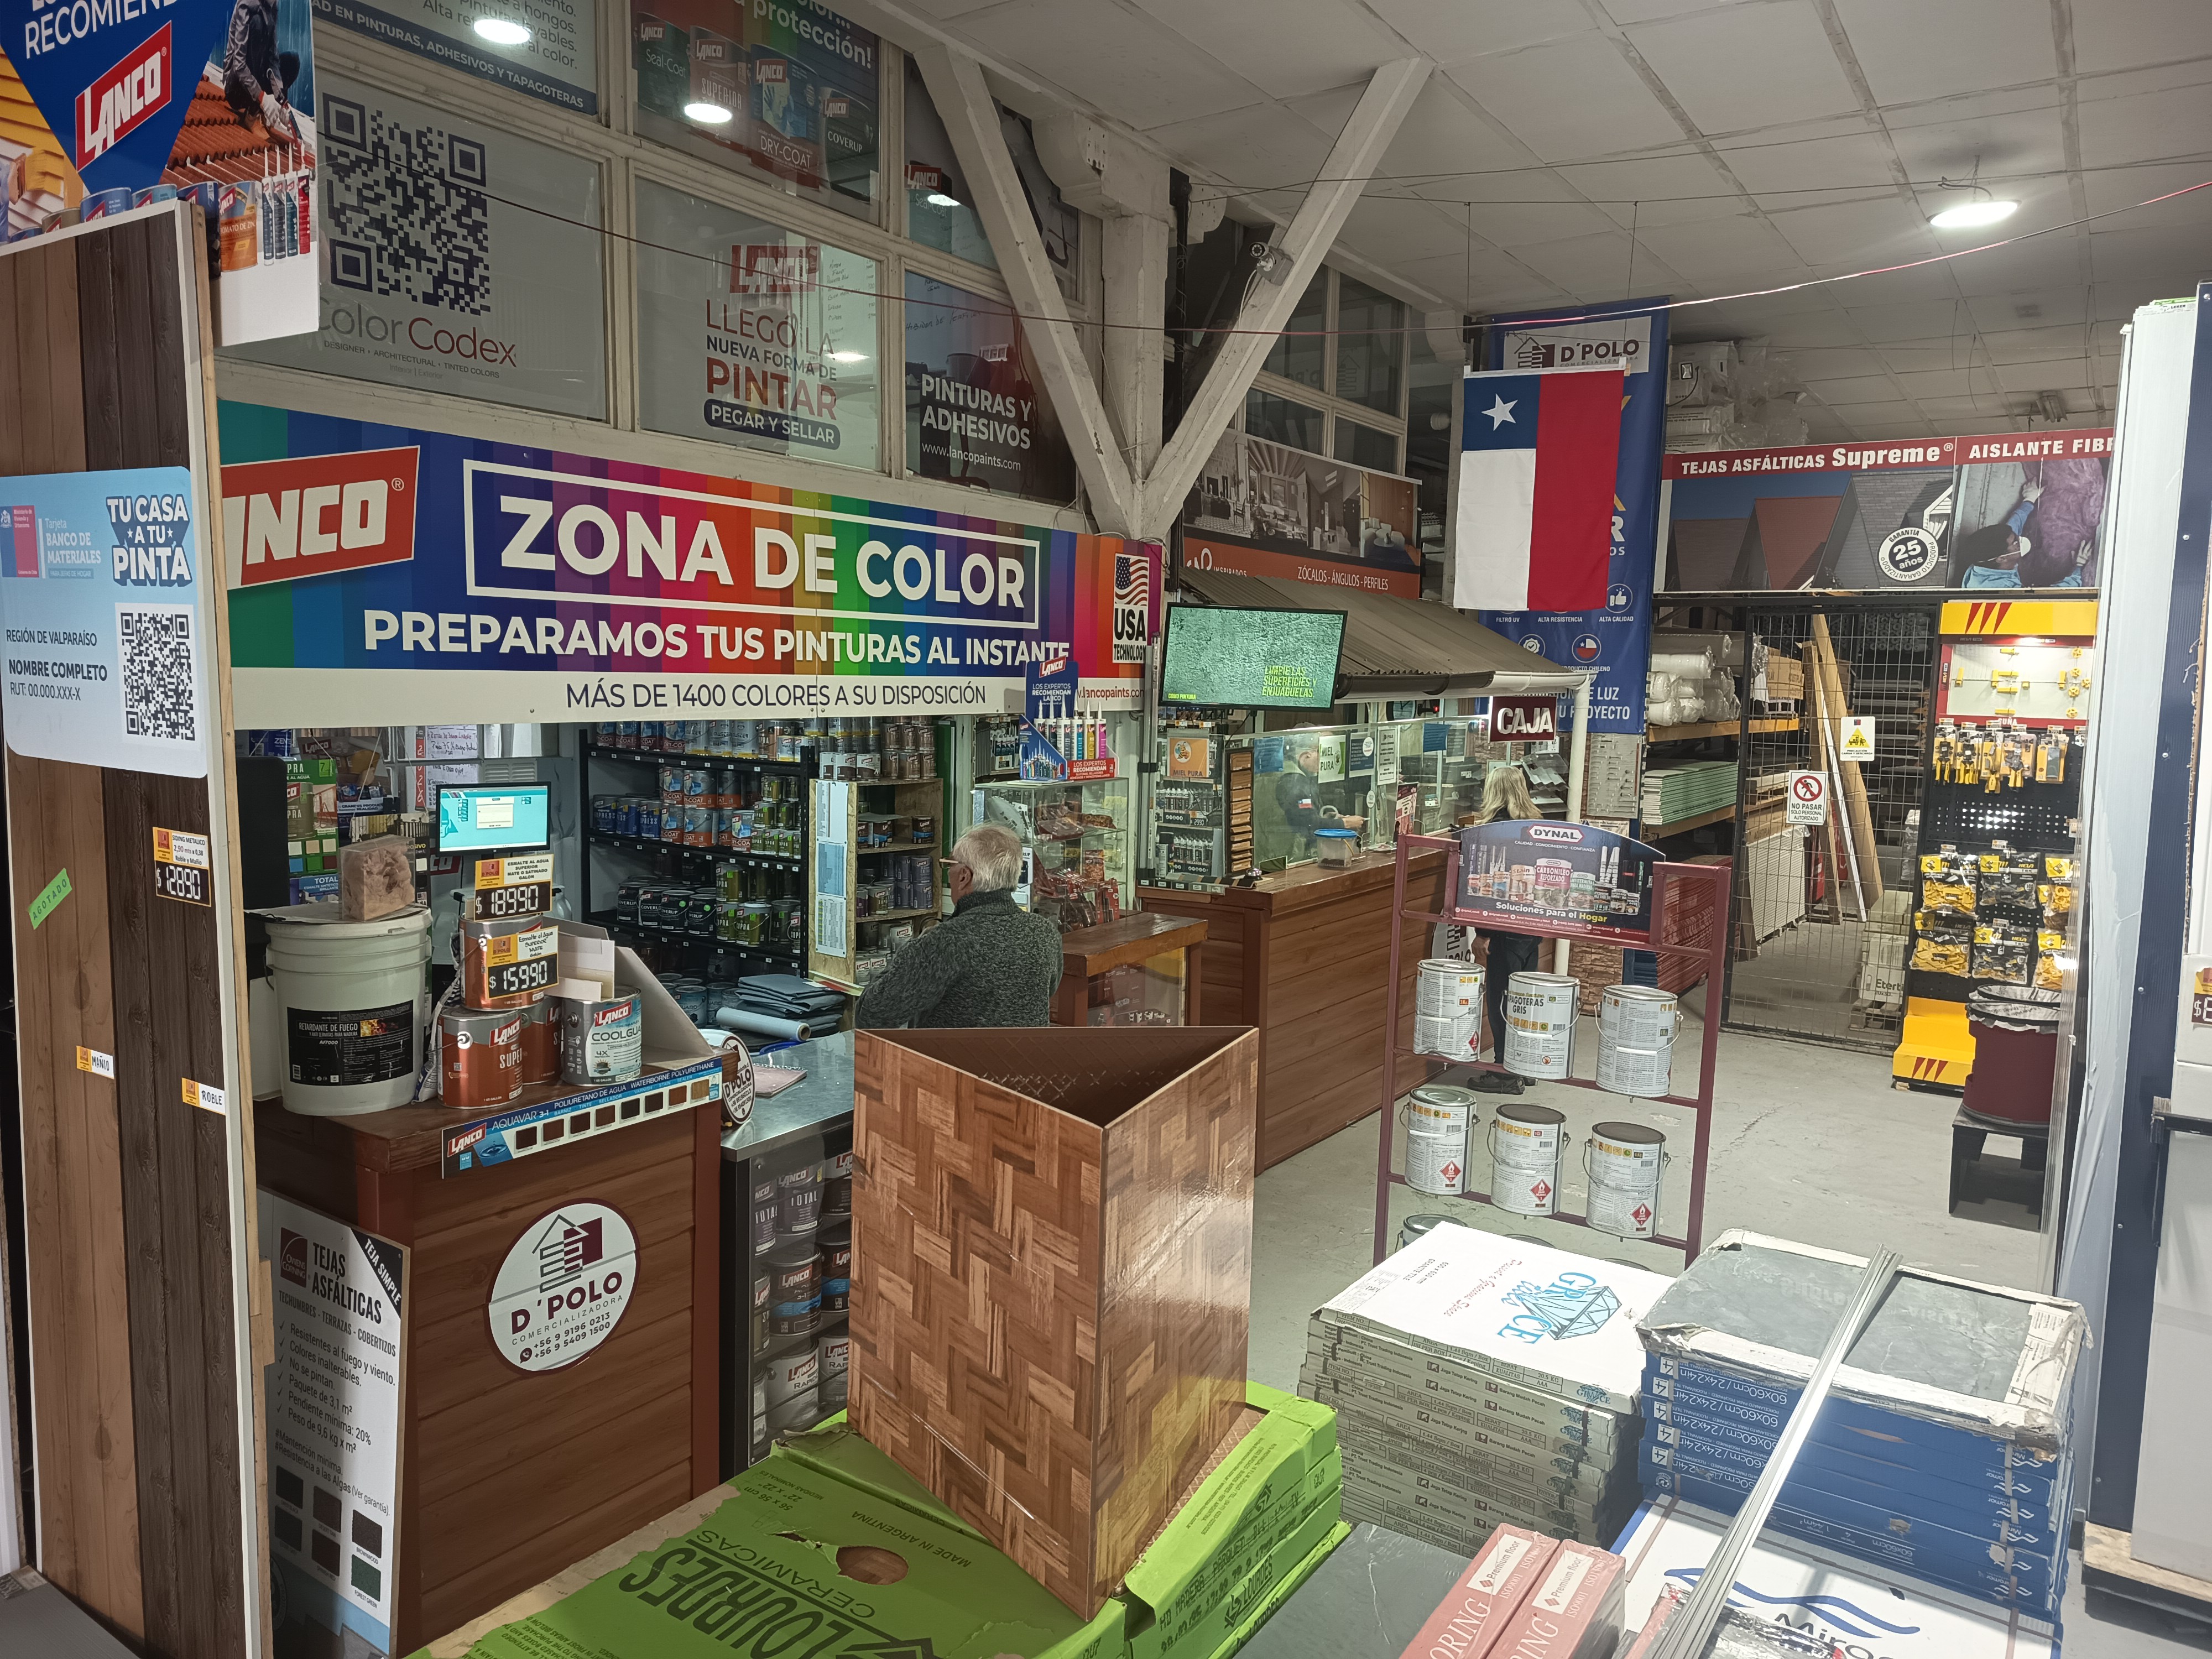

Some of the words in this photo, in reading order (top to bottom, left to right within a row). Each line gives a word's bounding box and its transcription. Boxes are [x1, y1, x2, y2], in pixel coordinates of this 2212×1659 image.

[336, 7, 353, 22] EN
[357, 12, 424, 50] PINTURAS,
[426, 40, 494, 75] ADHESIVOS
[497, 67, 504, 78] Y
[507, 70, 583, 108] TAPAGOTERAS
[542, 46, 577, 70] color.
[646, 49, 686, 79] Seal-Coat
[755, 61, 784, 84] LANCO
[85, 51, 160, 158] LANCO
[701, 79, 742, 110] SUPERIOR
[760, 135, 811, 169] DRY-COAT
[827, 130, 863, 153] COVERUP
[707, 299, 796, 348] LLEGÓ
[806, 327, 834, 357] LA
[409, 317, 517, 368] Codex
[324, 340, 365, 354] DESIGNER
[373, 350, 436, 367] ARCHITECTURAL
[444, 363, 469, 373] TINTED
[471, 367, 500, 379] COLORS
[707, 335, 760, 362] NUEVA
[764, 349, 815, 376] FORMA
[819, 363, 837, 382] DE
[707, 357, 837, 420] PINTAR
[922, 374, 1016, 416] PINTURAS
[1020, 400, 1031, 422] Y
[711, 405, 764, 430] PEGAR
[768, 418, 778, 432] Y
[781, 419, 834, 444] SELLAR
[922, 405, 1030, 450] ADHESIVOS
[922, 443, 1021, 471] www.lancopaints.com
[1682, 460, 1728, 476] TEJAS
[1732, 453, 1825, 473] ASFÁLTICAS
[1832, 444, 1940, 468] Supreme
[1969, 440, 2063, 459] AISLANTE
[107, 498, 132, 523] TU
[134, 497, 189, 521] CASA
[44, 518, 67, 531] Tarjeta
[134, 526, 145, 544] A
[147, 526, 165, 543] TU
[46, 533, 77, 546] BANCO
[80, 532, 91, 546] DE
[500, 495, 735, 587] ZONA
[755, 527, 838, 594] DE
[856, 540, 1025, 608] COLOR
[1892, 540, 1922, 561] 25
[48, 550, 101, 564] MATERIALES
[113, 547, 191, 580] PINTA
[1899, 556, 1924, 570] años
[1297, 564, 1327, 583] ZÓCALOS
[1331, 567, 1360, 587] ÁNGULOS
[1364, 573, 1389, 591] PERFILES
[6, 627, 35, 644] REGIÓN
[38, 630, 48, 643] DE
[49, 627, 97, 646] VALPARAÍSO
[364, 609, 687, 659] PREPARAMOS
[696, 625, 764, 661] TUS
[774, 628, 922, 665] PINTURAS
[927, 636, 960, 665] AL
[966, 637, 1070, 666] INSTANTE
[1115, 608, 1147, 644] USA
[1113, 644, 1146, 661] TECHNOLOGY
[9, 659, 49, 678] NOMBRE
[51, 662, 108, 681] COMPLETO
[1042, 660, 1063, 676] LANCO
[1264, 665, 1291, 677] LIMPIE
[1292, 666, 1306, 677] LAS
[10, 682, 27, 697] RUT:
[28, 683, 81, 701] 00.000.XXX-X
[567, 678, 626, 709] MÁS
[633, 685, 666, 708] DE
[675, 682, 726, 707] 1400
[732, 684, 831, 708] COLORES
[834, 685, 849, 706] A
[853, 685, 878, 706] SU
[883, 680, 987, 706] DISPOSICIÓN
[1263, 676, 1310, 687] SUPERFICIES
[1597, 687, 1620, 701] LUZ
[1497, 707, 1553, 734] CAJA
[1320, 744, 1334, 758] MIEL
[1319, 759, 1334, 771] PURA
[172, 834, 185, 843] SIDING
[185, 837, 205, 846] METALICO
[1534, 828, 1579, 840] DYNAL
[1536, 866, 1571, 877] CARBONILEO
[1540, 873, 1566, 883] REFORZADO
[32, 878, 67, 921] AGOTADO
[491, 885, 539, 915] 18990
[1495, 901, 1545, 915] Soluciones
[1546, 909, 1566, 919] para
[1578, 912, 1608, 923] Hogar
[503, 960, 547, 991] 15990
[599, 1006, 629, 1025] LANCO
[1512, 1004, 1527, 1015] GRIS
[299, 1022, 328, 1032] RETARDANTE
[339, 1022, 358, 1031] FUEGO
[494, 1021, 520, 1045] LANCO
[91, 1055, 110, 1072] MAÑIO
[554, 1090, 598, 1109] POLIURETANO
[609, 1084, 627, 1095] AGUA
[630, 1072, 670, 1089] WATERBORNE
[671, 1061, 714, 1078] POLYURETHANE
[201, 1090, 223, 1106] ROBLE
[492, 1110, 538, 1131] AQUAVAR
[450, 1130, 483, 1155] LANCO
[313, 1242, 346, 1278] TEJAS
[364, 1238, 380, 1267] TEJA
[378, 1263, 402, 1306] SIMPLE
[311, 1271, 382, 1324] ASFÁLTICAS
[279, 1290, 316, 1318] TECHUMBRES
[322, 1311, 352, 1335] TERRAZAS
[357, 1328, 397, 1357] COBERTIZOS
[512, 1294, 624, 1346] COMERCIALIZADORA
[534, 1337, 551, 1349] +56
[564, 1321, 586, 1337] 9196
[589, 1311, 611, 1329] 0213
[290, 1323, 331, 1353] Resistentes
[341, 1348, 362, 1369] fuego
[370, 1364, 395, 1386] viento.
[1496, 1368, 1521, 1379] KUALITAS
[1499, 1388, 1515, 1399] Barang
[1516, 1393, 1531, 1402] Mudah
[1531, 1399, 1546, 1407] Pecah
[1724, 1404, 1778, 1428] 60x60cm
[851, 1510, 920, 1547] ARGENTINA
[915, 1538, 931, 1551] IN
[933, 1545, 972, 1568] MADE
[1486, 1557, 1509, 1580] Premium
[1505, 1540, 1521, 1563] floor
[696, 1529, 877, 1619] CERAMICAS
[1244, 1554, 1274, 1606] LOURDES
